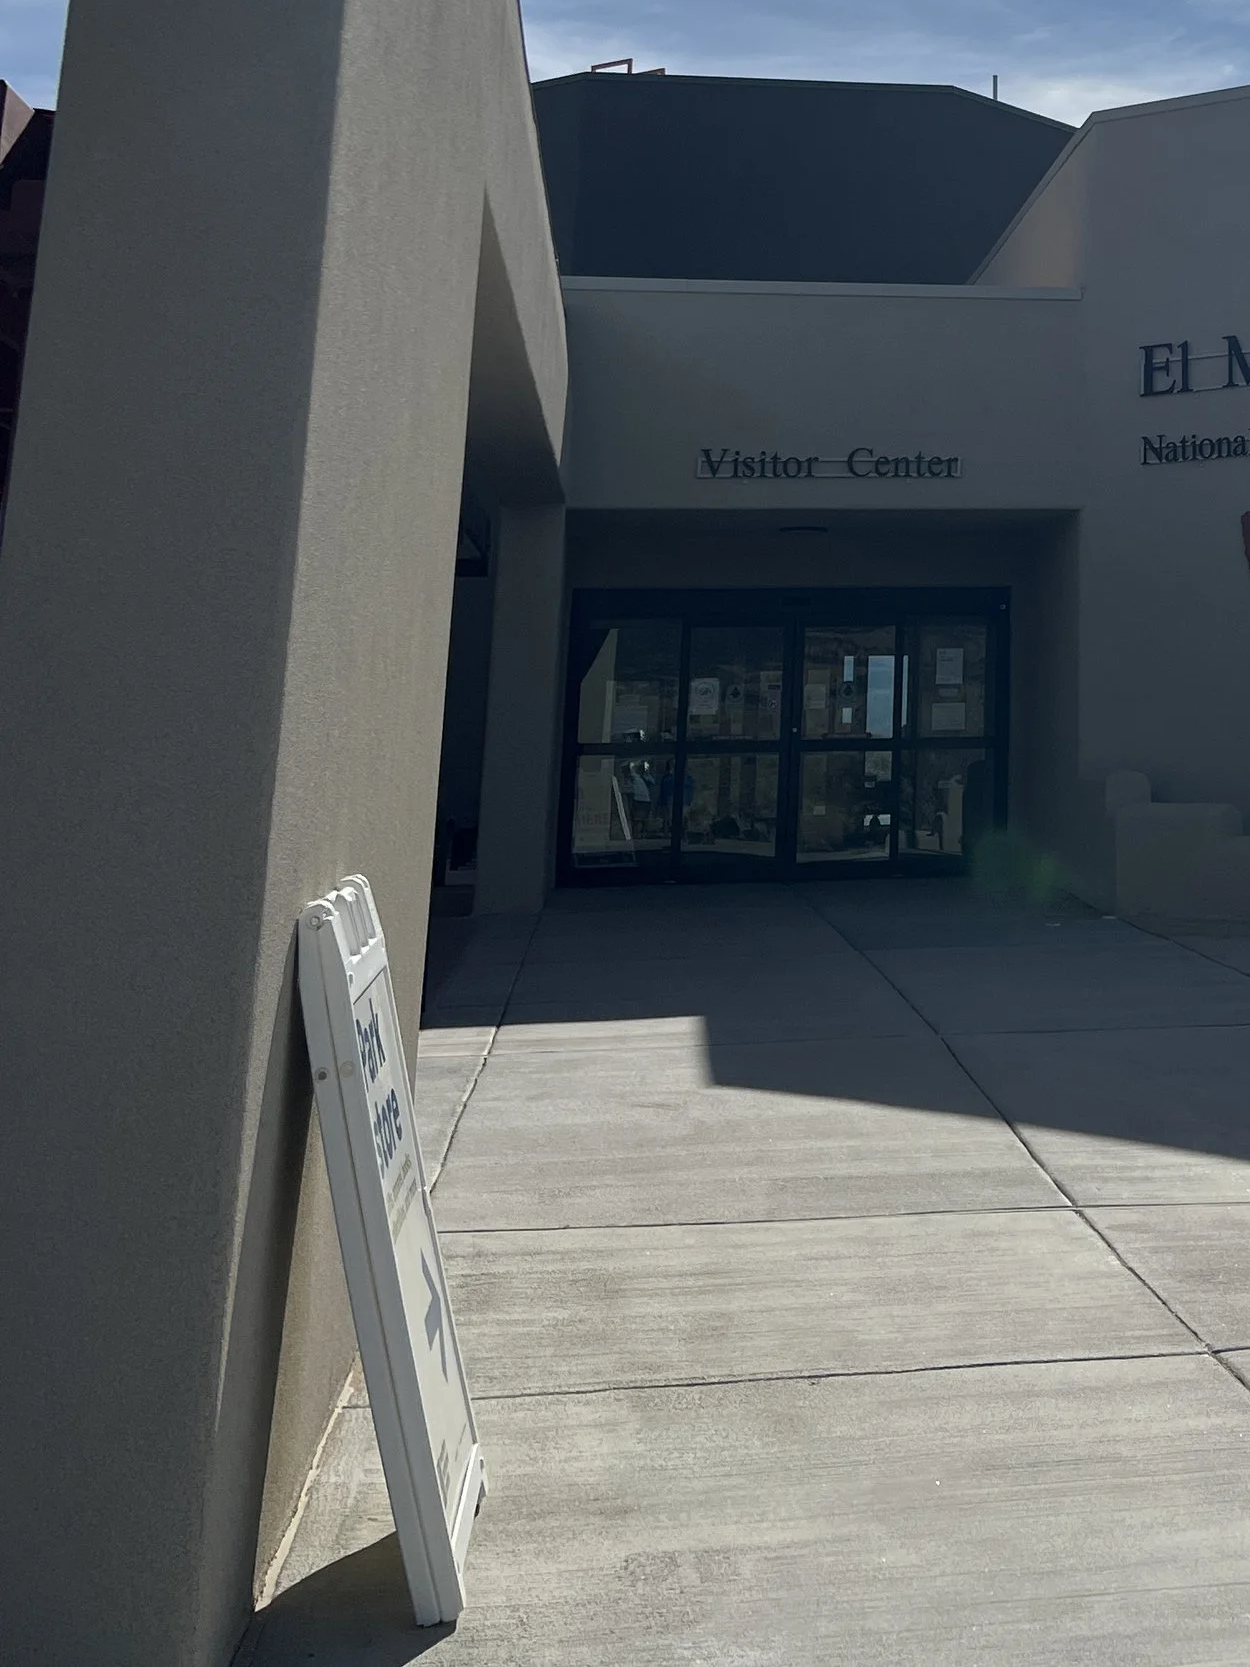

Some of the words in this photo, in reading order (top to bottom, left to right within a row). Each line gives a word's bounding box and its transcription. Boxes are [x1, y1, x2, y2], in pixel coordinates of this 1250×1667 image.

[1140, 340, 1193, 396] El
[701, 448, 820, 478] Visitor
[847, 447, 960, 478] Center
[356, 998, 385, 1094] Park
